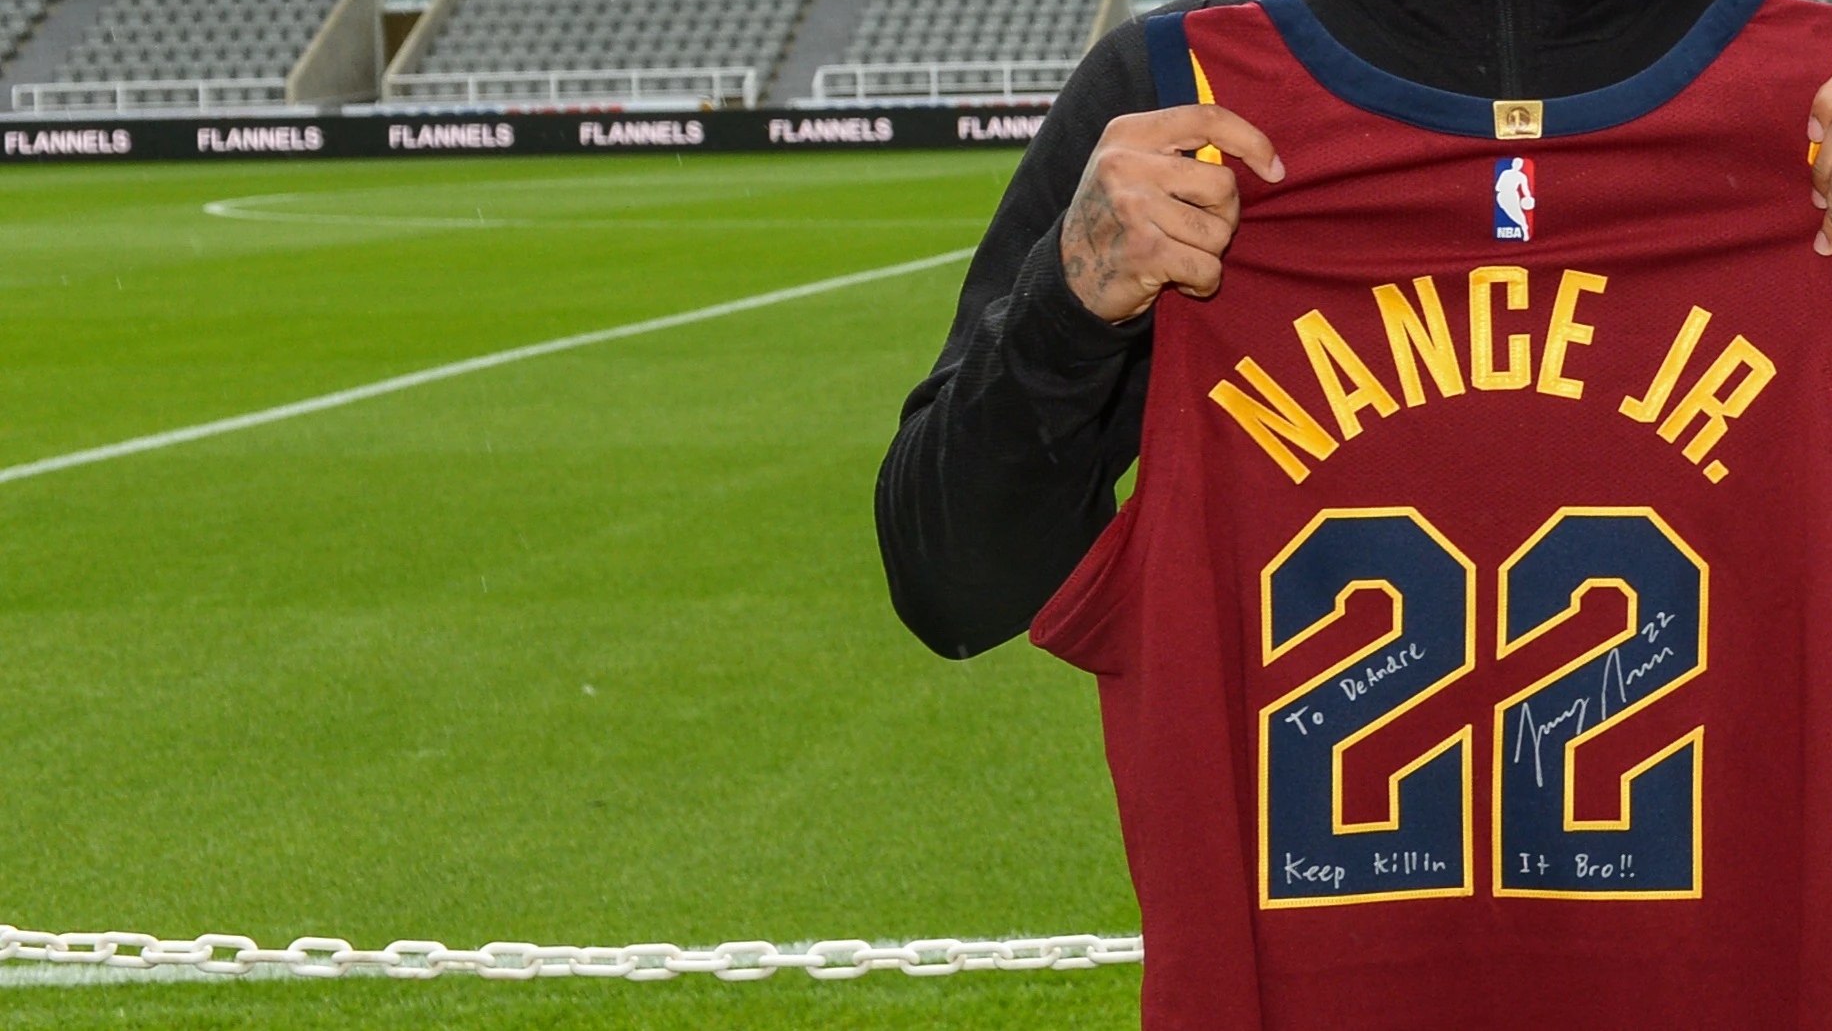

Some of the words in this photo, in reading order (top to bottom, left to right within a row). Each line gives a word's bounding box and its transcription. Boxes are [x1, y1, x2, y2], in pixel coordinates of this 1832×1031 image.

[4, 128, 132, 155] FLANNELS
[197, 126, 325, 153] FLANNELS
[389, 123, 516, 150] FLANNELS
[579, 120, 705, 146] FLANNELS
[769, 117, 894, 143] FLANNELS
[1497, 226, 1522, 239] NBA
[1208, 265, 1609, 485] NANCE
[1617, 304, 1778, 485] JR.
[1640, 611, 1676, 643] 22
[1284, 705, 1325, 736] To
[1339, 642, 1427, 702] DeAndre
[1259, 506, 1709, 910] 22
[1284, 852, 1346, 888] Keep
[1519, 853, 1550, 875] It
[1574, 853, 1636, 879] Bro!!
